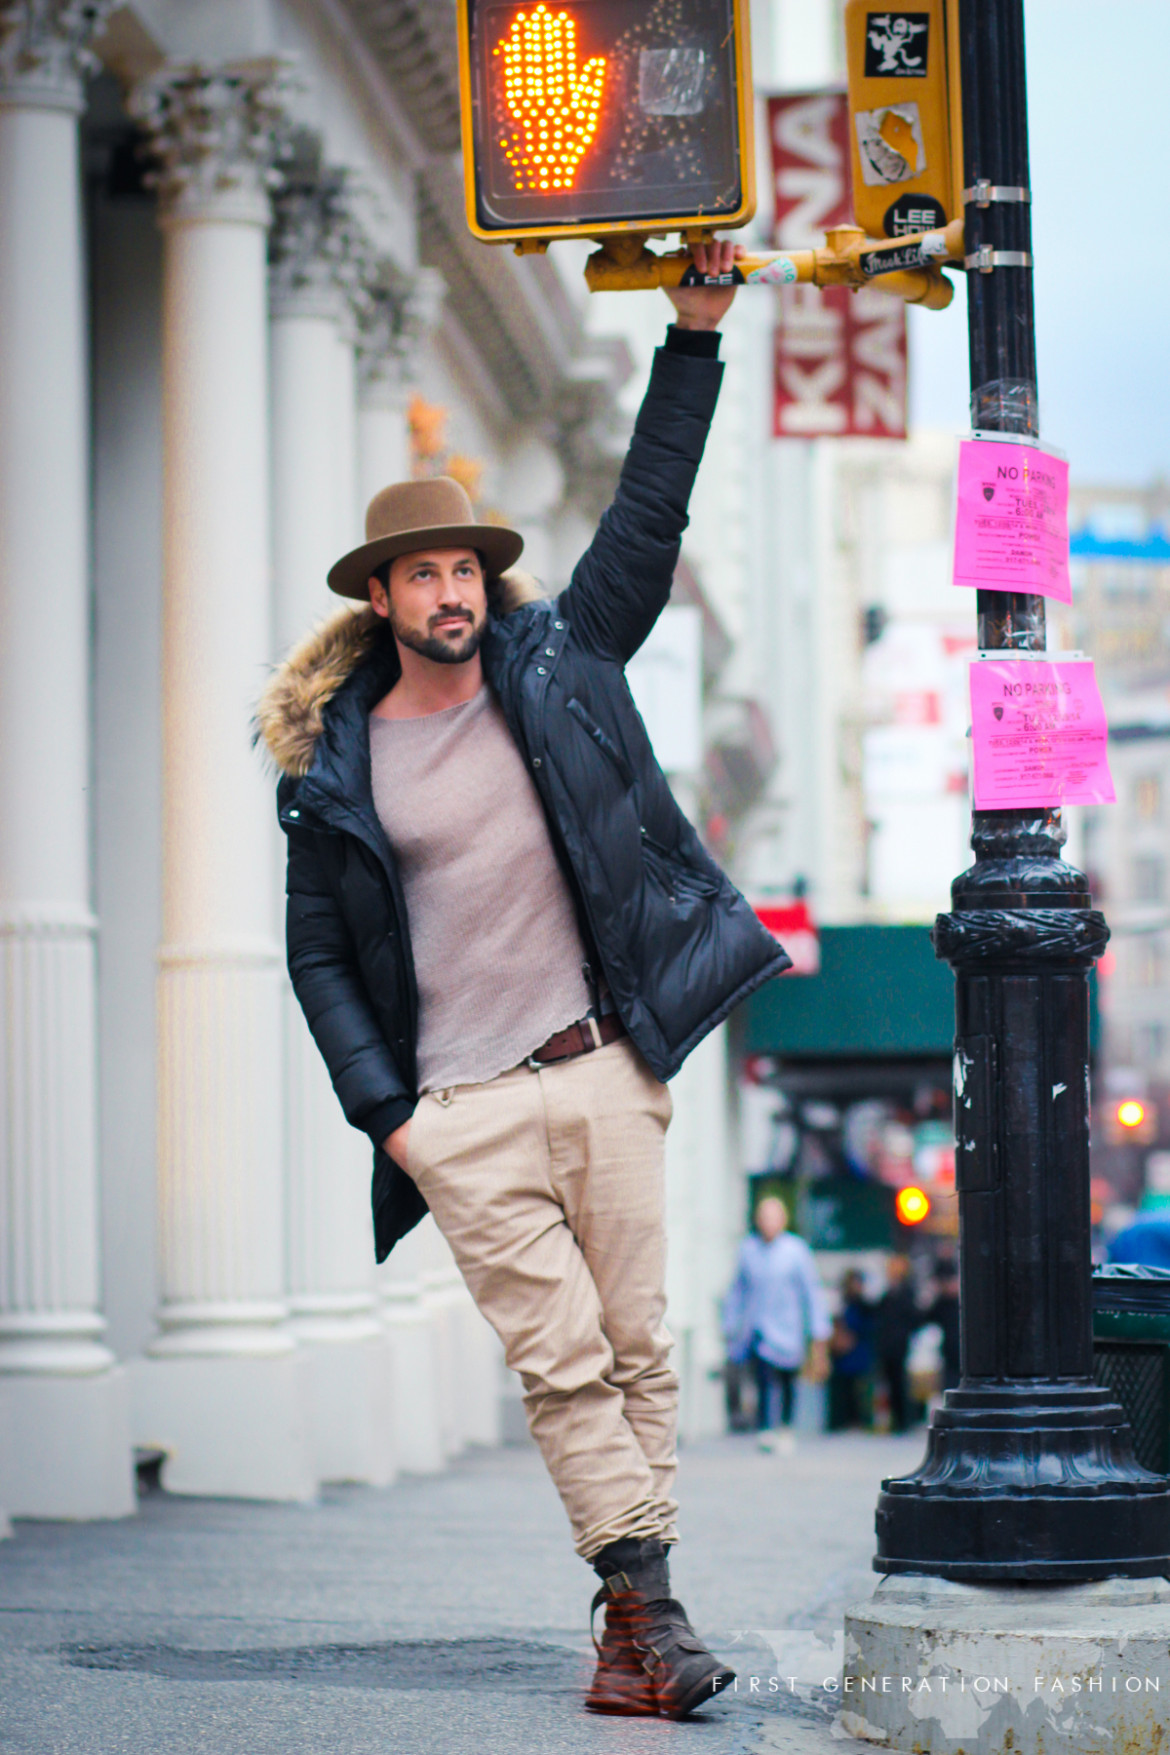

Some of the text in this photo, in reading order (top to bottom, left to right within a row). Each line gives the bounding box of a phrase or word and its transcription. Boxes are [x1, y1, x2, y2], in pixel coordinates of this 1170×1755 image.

[893, 208, 936, 225] LEE
[997, 466, 1056, 490] NO PARKING
[1003, 682, 1072, 697] NO PARKING
